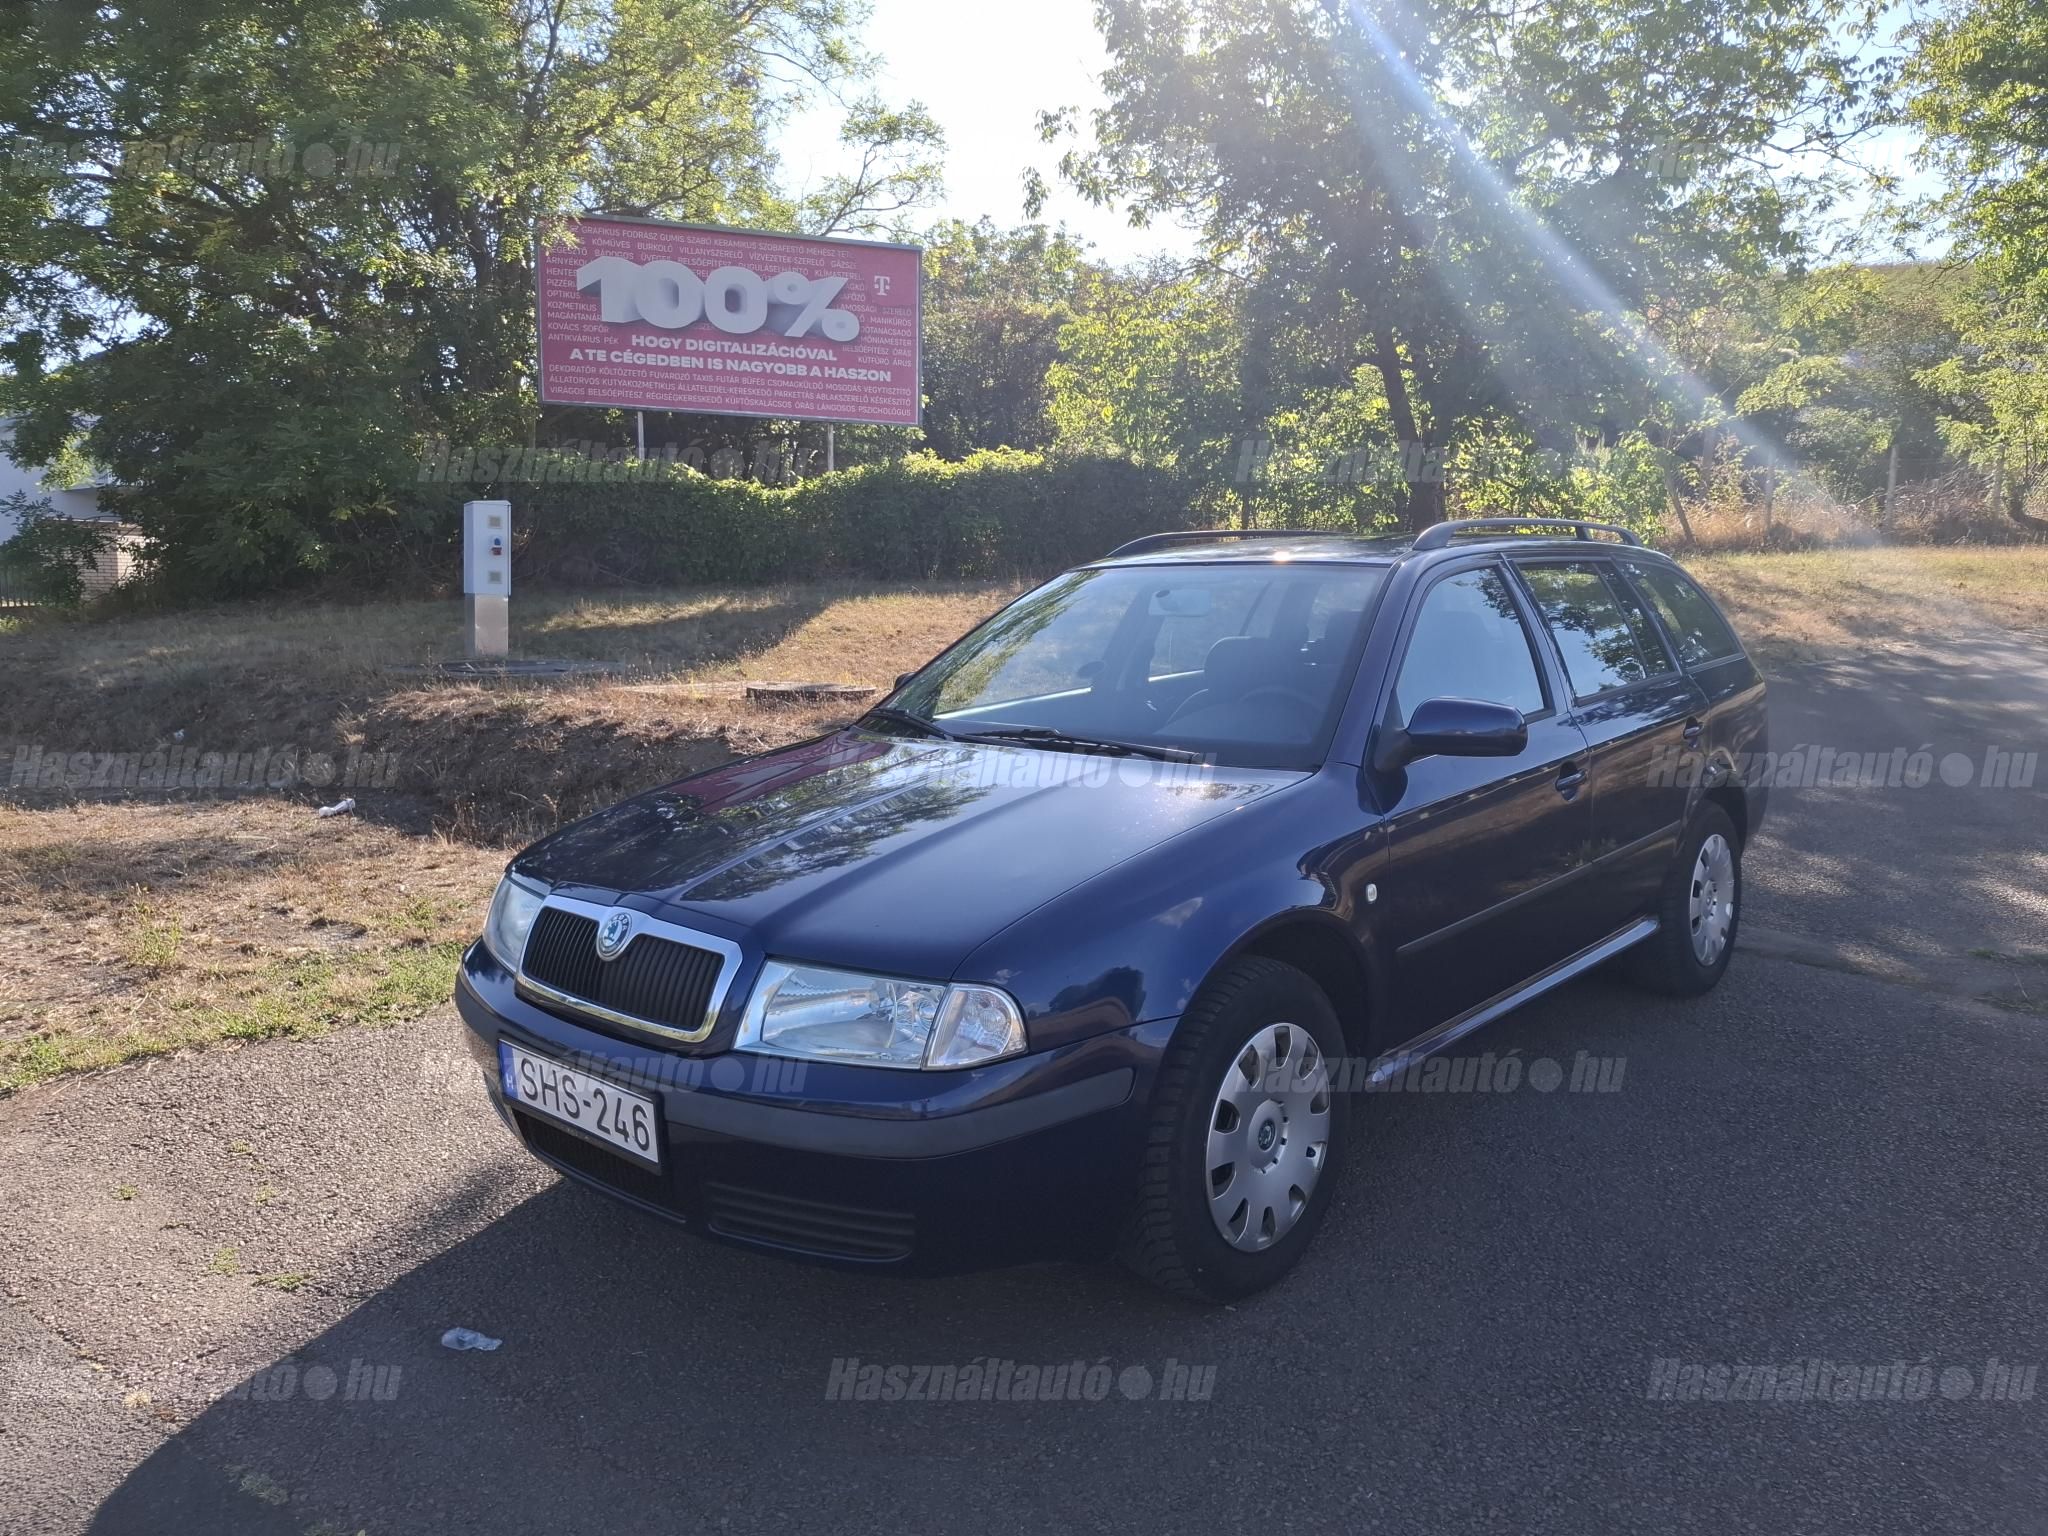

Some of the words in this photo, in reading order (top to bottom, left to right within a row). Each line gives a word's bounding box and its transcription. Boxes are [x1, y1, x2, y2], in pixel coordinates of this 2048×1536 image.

[582, 227, 620, 237] GRAFIKUS
[660, 234, 684, 243] GUMIS
[638, 242, 672, 253] BURKOLÓ
[680, 246, 743, 259] VILLANYSZERELŐ
[547, 290, 580, 299] OPTIKUS
[576, 256, 860, 342] 100%
[548, 301, 597, 312] KOZMETIKUS
[548, 322, 579, 331] KOVÁCS
[548, 332, 600, 344] ANTIKVÁRIUS
[604, 336, 619, 345] PÉK
[632, 335, 682, 350] HOGY
[686, 339, 837, 361] DIGITALIZÁCIÓVAL
[570, 348, 583, 360] A
[585, 349, 607, 362] TE
[610, 349, 704, 369] CÉGEDBEN
[708, 358, 723, 370] IS
[727, 359, 807, 376] NAGYOBB
[810, 366, 822, 377] A
[825, 366, 891, 382] HASZON
[549, 375, 599, 386] ÁLLATORVOS
[603, 379, 675, 391] KUTYAKOZMETIKUS
[650, 371, 690, 381] FUVAROZÓ
[693, 374, 714, 382] TAXIS
[716, 375, 739, 384] FUTÁR
[551, 386, 585, 395] VIRÁGOS
[505, 1073, 514, 1090] H
[520, 1057, 651, 1152] SHS-246
